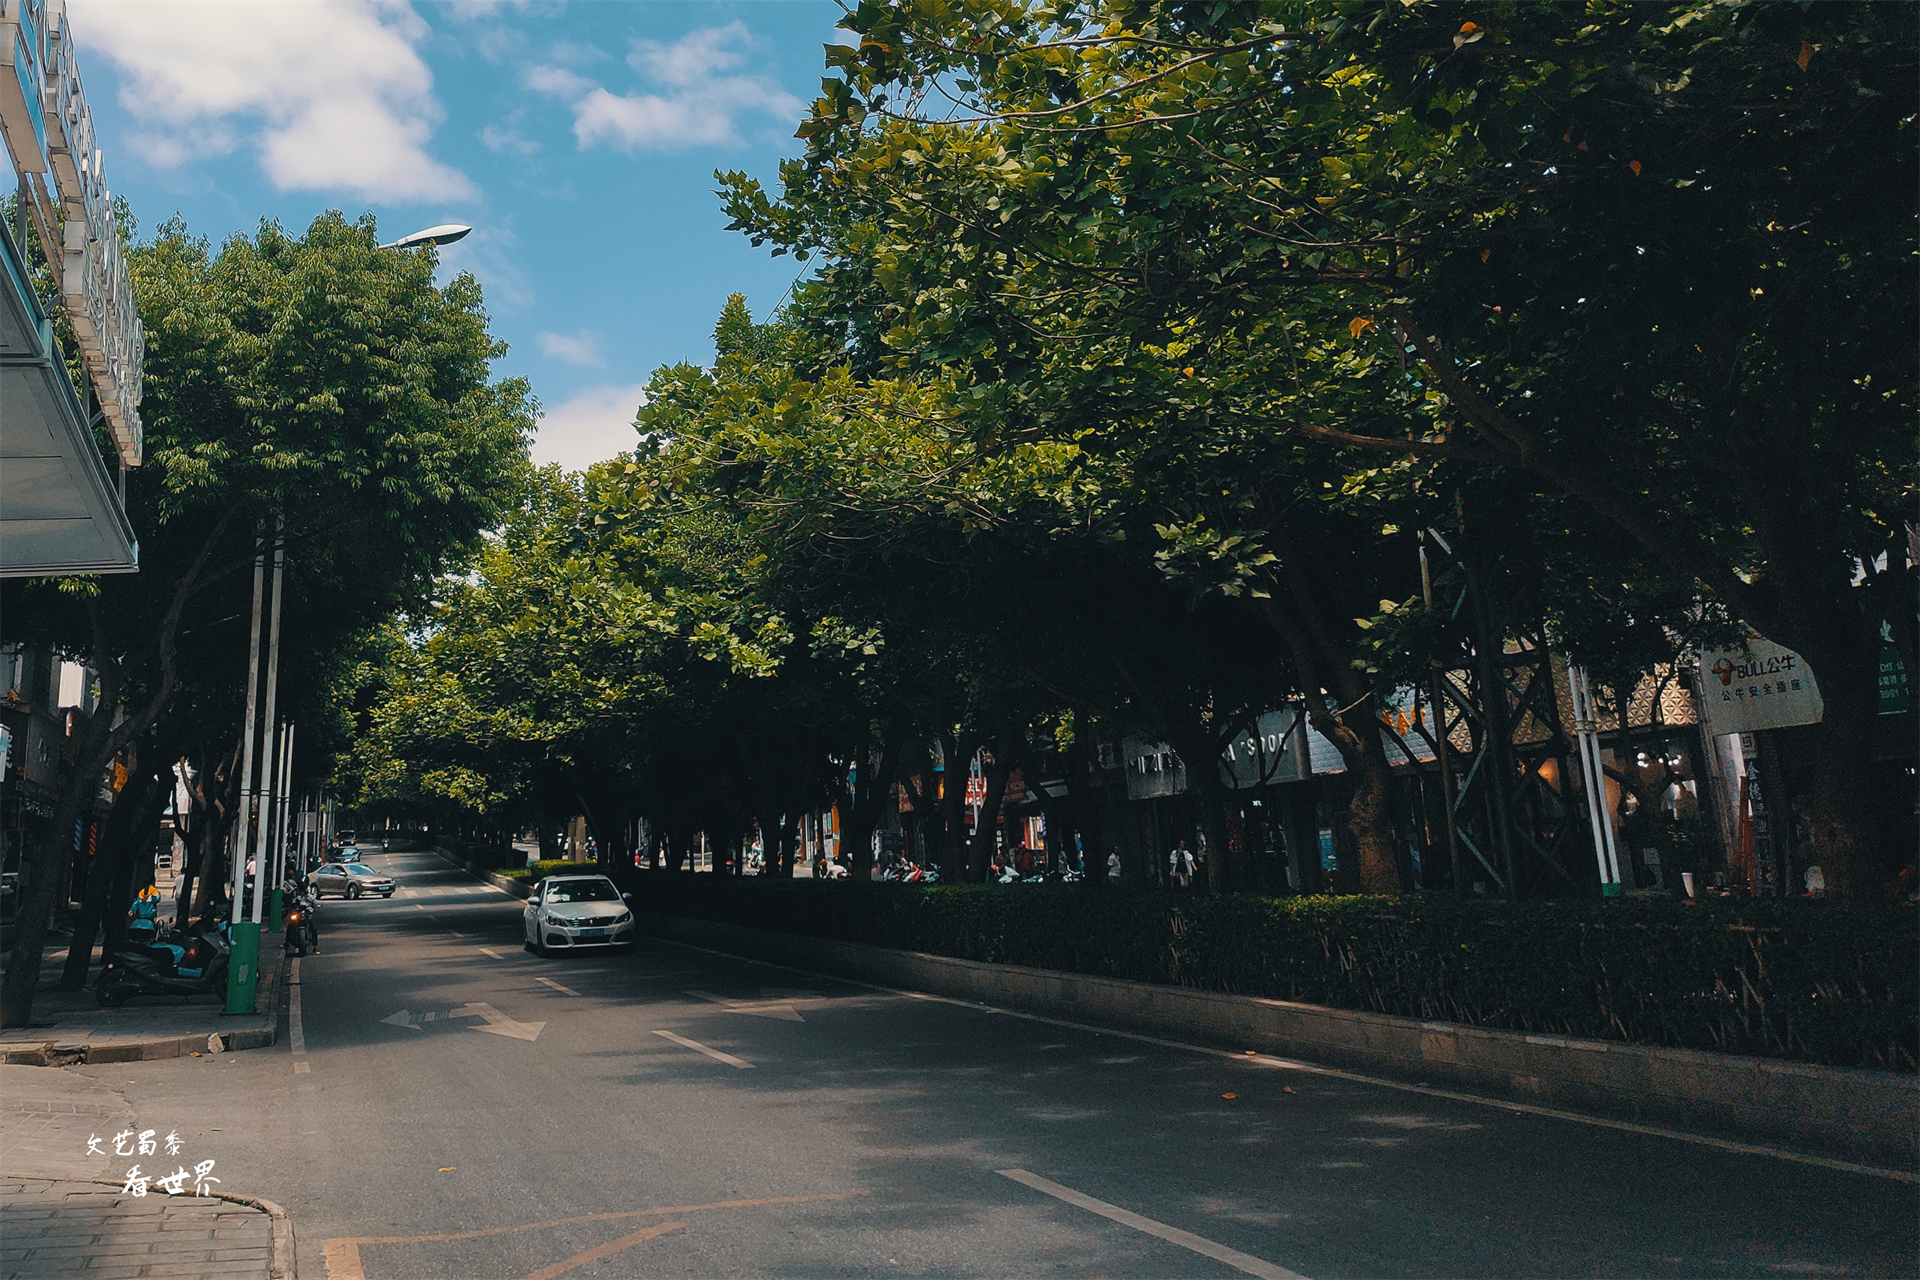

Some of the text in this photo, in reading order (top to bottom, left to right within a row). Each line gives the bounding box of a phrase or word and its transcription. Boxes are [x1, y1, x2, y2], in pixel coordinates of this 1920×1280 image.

[1721, 678, 1802, 701] 公牛安全插座
